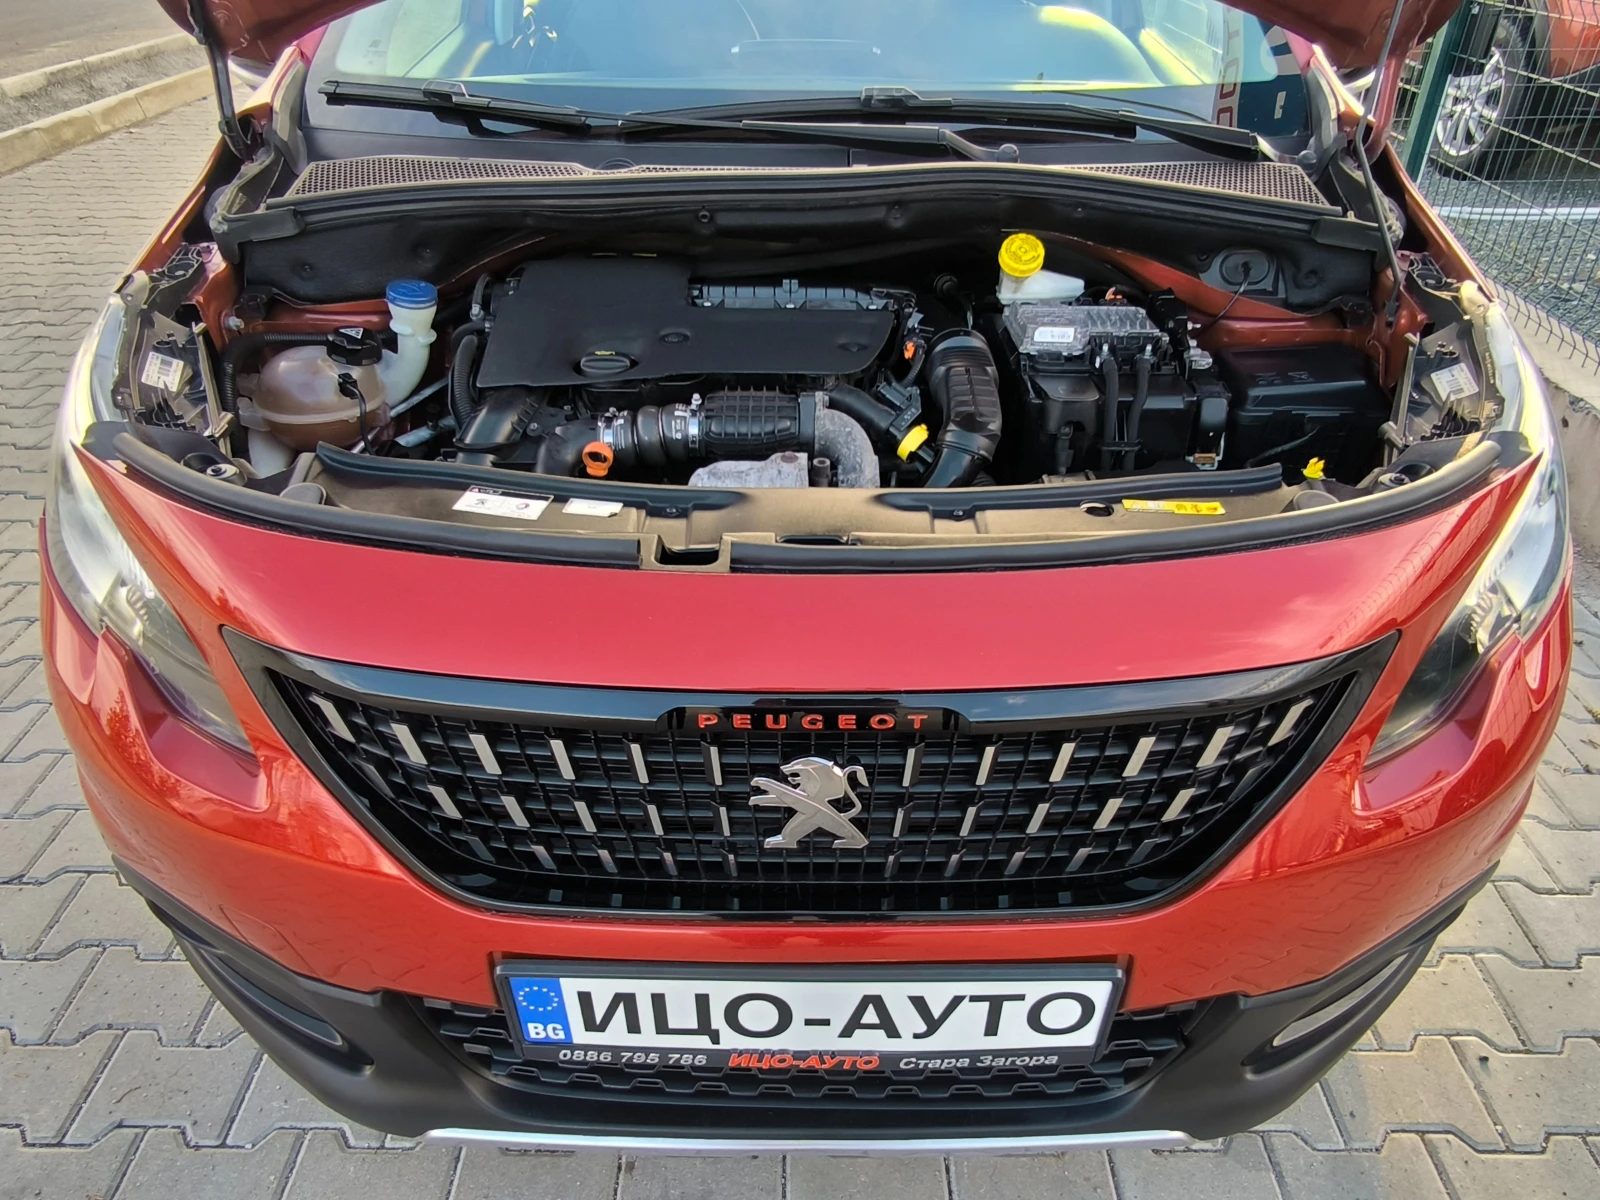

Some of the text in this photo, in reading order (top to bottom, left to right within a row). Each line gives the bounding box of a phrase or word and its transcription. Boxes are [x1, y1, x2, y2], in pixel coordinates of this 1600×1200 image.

[697, 713, 929, 730] PEUGEOT
[577, 990, 1096, 1045] ИЦО-АУТО
[527, 1022, 566, 1040] BG
[558, 1049, 708, 1066] 0886 795 786
[728, 1053, 880, 1070] ИЦО-АУТО
[899, 1055, 1059, 1070] Стара Загора
